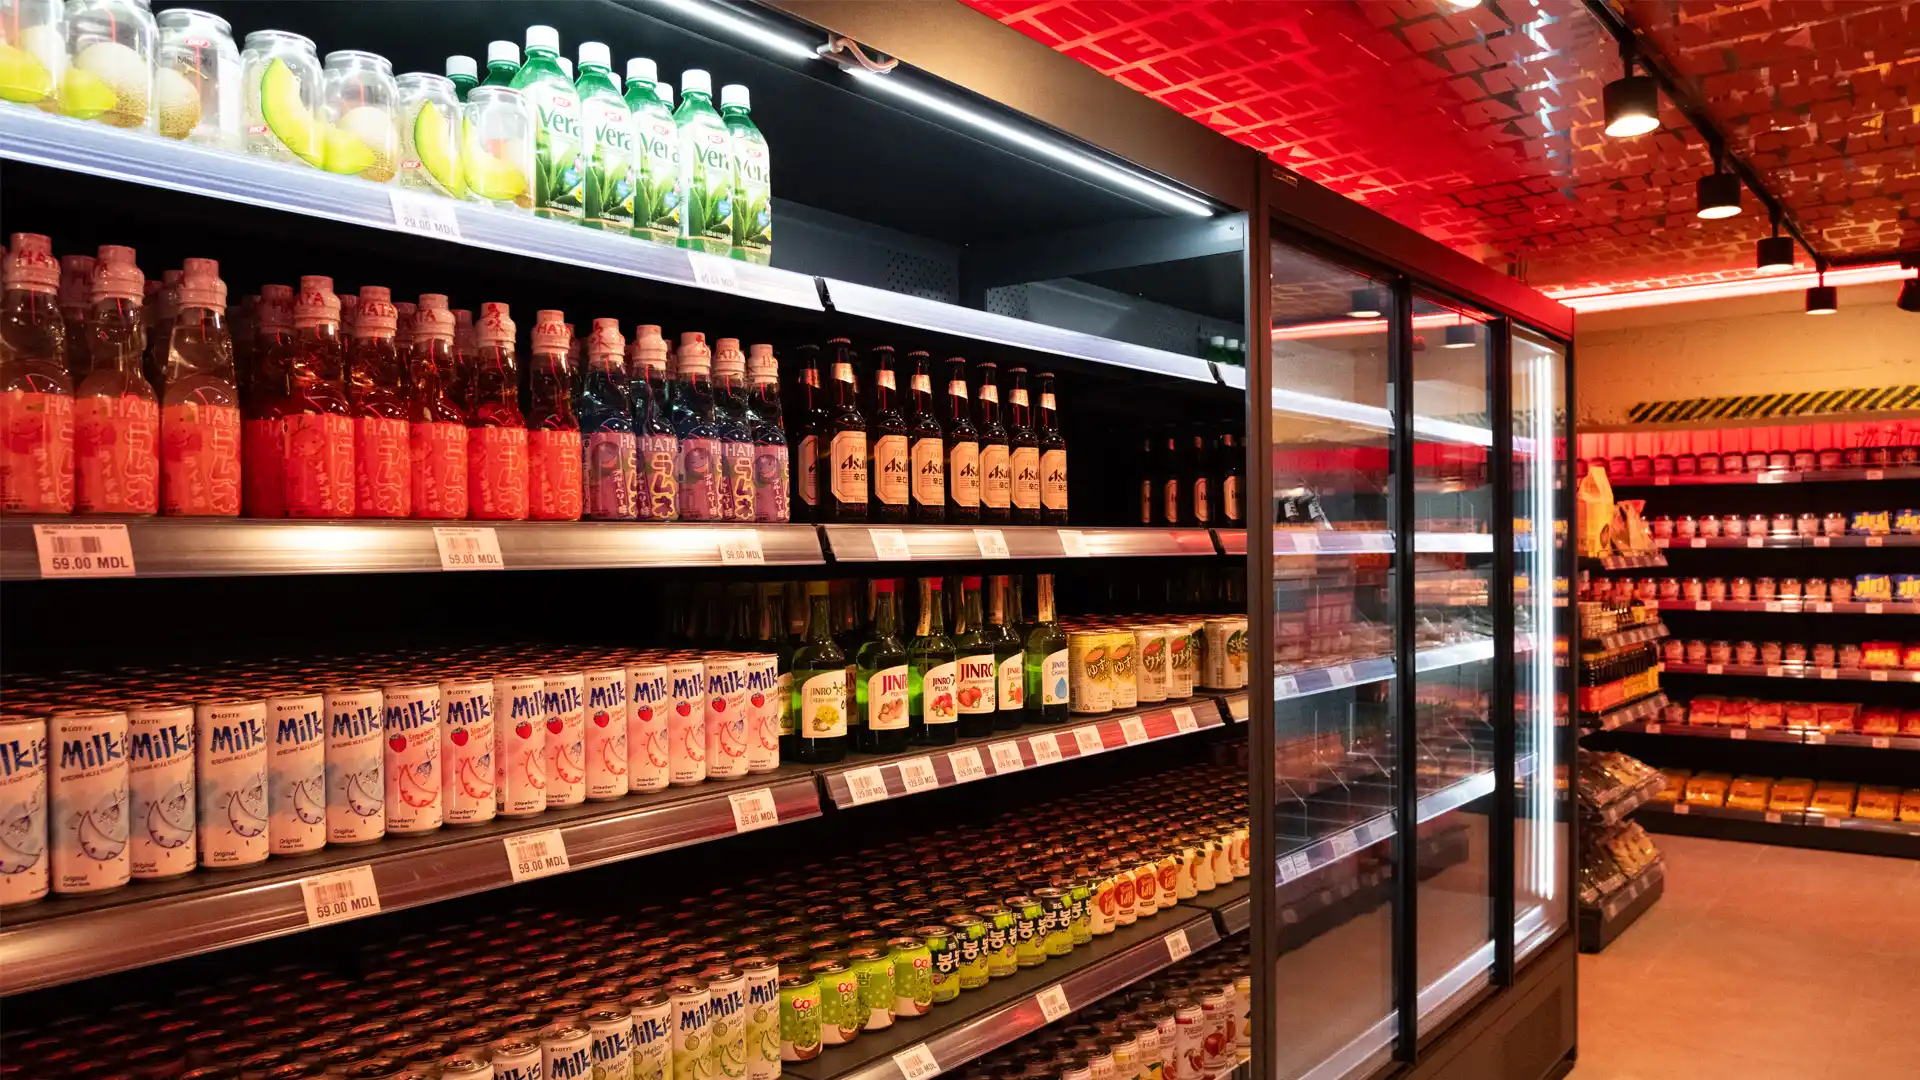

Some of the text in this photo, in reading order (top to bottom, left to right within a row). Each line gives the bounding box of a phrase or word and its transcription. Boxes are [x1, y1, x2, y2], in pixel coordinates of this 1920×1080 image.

[537, 103, 580, 137] Vera
[595, 123, 631, 150] Vera
[640, 132, 680, 163] Vera
[194, 408, 240, 427] HAT
[364, 419, 408, 437] HATA
[486, 427, 528, 444] HATA
[641, 437, 678, 452] HATA
[652, 452, 675, 518] ラムネ
[735, 458, 754, 520] ラムネ
[52, 556, 129, 570] 59.00 MDL
[448, 553, 500, 564] 59.00 MDL
[746, 550, 761, 559] MDL
[960, 663, 993, 682] JINRO
[933, 676, 951, 687] JINRO
[810, 687, 831, 697] JINRO
[760, 811, 775, 820] MDL
[518, 856, 565, 873] 59.00 MDL
[317, 896, 376, 918] 59.00 MDL
